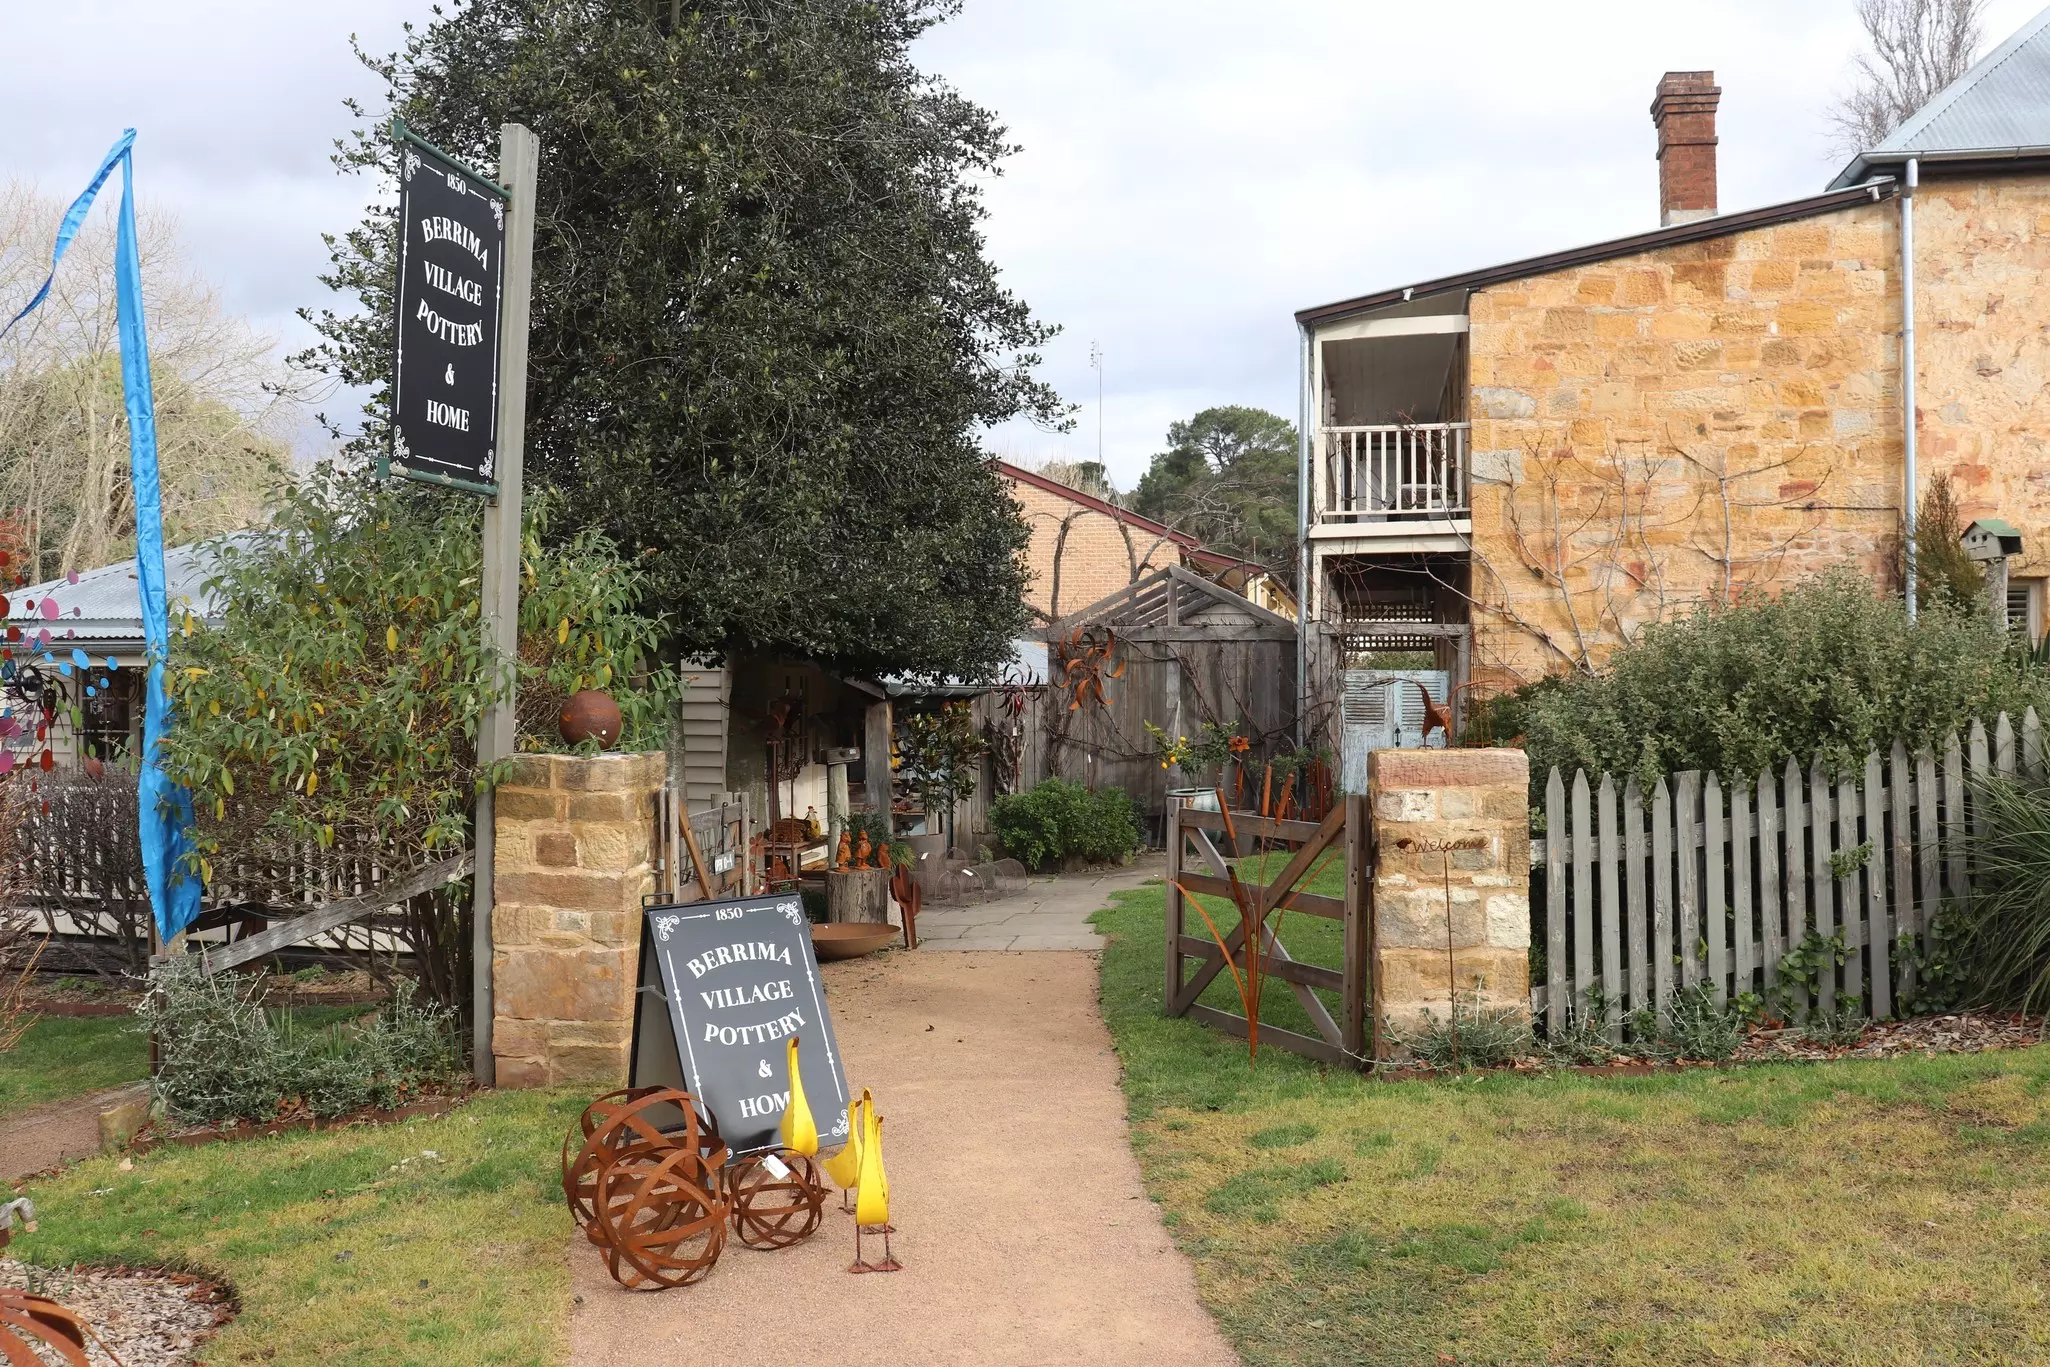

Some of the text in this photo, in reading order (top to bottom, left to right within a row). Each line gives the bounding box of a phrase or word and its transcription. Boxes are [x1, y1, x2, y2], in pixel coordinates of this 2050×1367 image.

[447, 172, 466, 195] 1850
[421, 216, 488, 271] BERRIMA
[424, 260, 482, 306] VILLAGE
[416, 298, 484, 347] POTTERY
[445, 363, 455, 386] &
[426, 399, 470, 432] HOME
[1412, 836, 1488, 852] Welcome
[715, 907, 743, 921] 1850
[686, 942, 792, 979] BERRIMA
[700, 980, 794, 1010] VILLAGE
[704, 1007, 806, 1046] POTTERY
[758, 1059, 773, 1078] &
[738, 1090, 791, 1119] HOM
